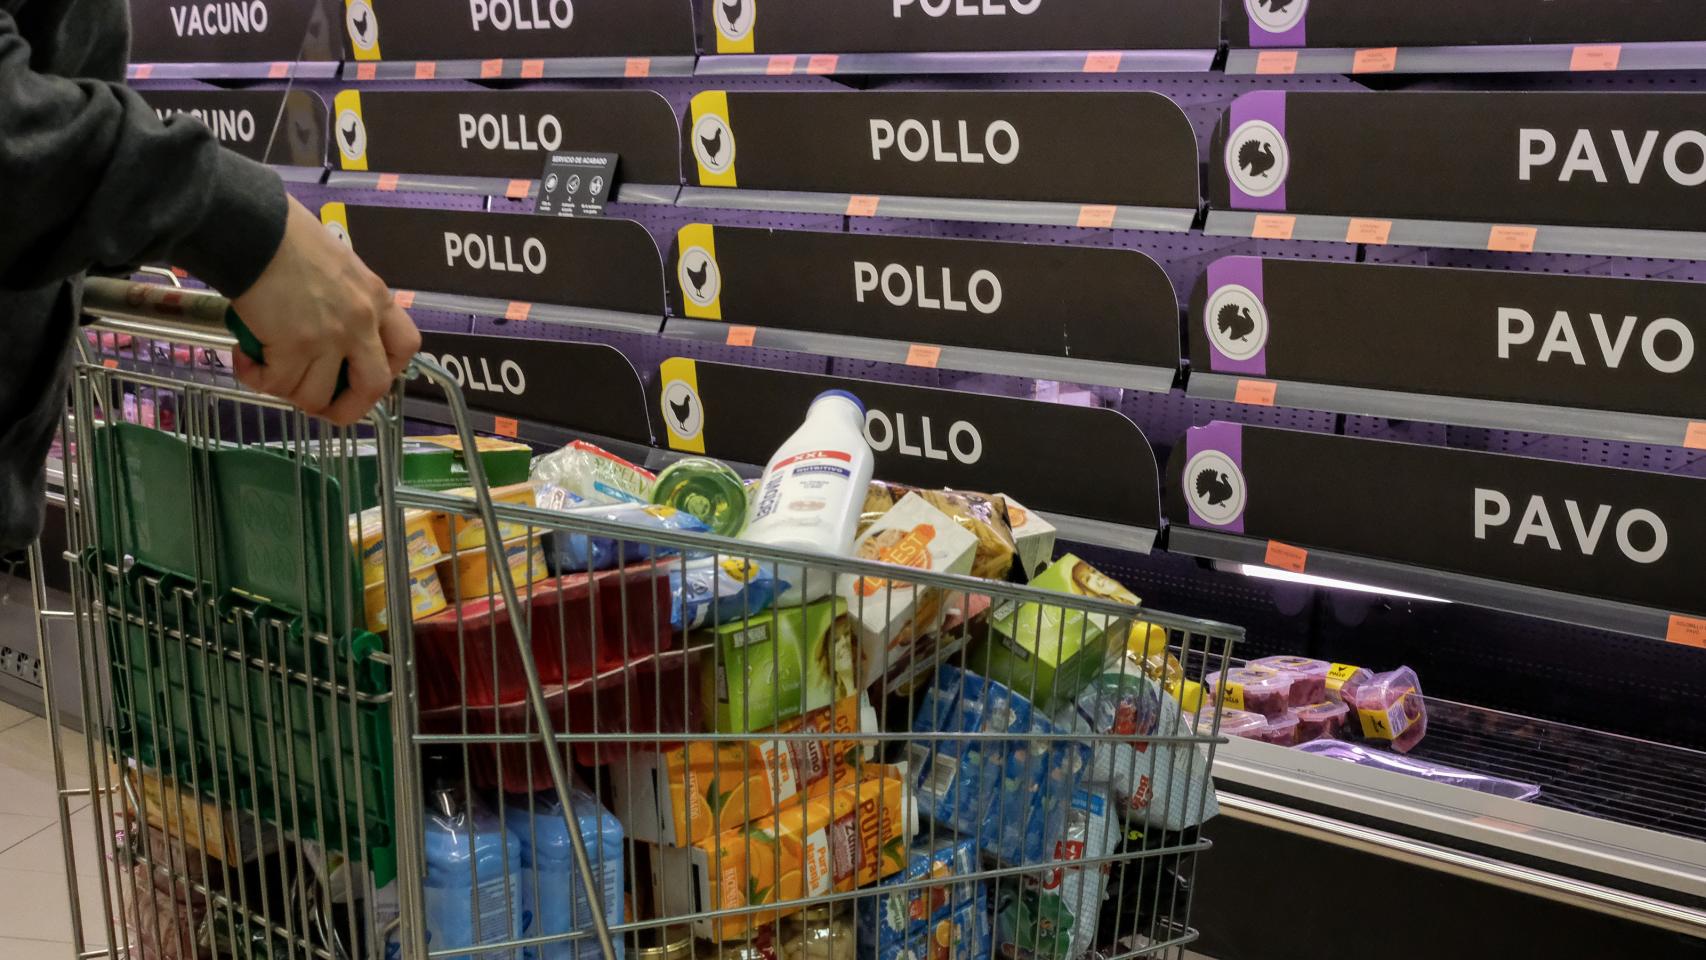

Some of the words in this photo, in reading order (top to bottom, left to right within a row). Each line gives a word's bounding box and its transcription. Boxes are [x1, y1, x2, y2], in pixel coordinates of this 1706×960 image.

[170, 0, 268, 37] VACUNO
[469, 0, 574, 32] POLLO
[458, 113, 562, 151] POLLO
[869, 118, 1020, 165] POLLO
[1518, 128, 1706, 186] PAVO
[444, 231, 547, 275] POLLO
[853, 261, 1003, 314] POLLO
[1497, 306, 1695, 374] PAVO
[794, 451, 827, 461] XXL
[863, 408, 983, 465] OLLO
[1474, 487, 1668, 564] PAVO
[817, 846, 829, 876] Pura
